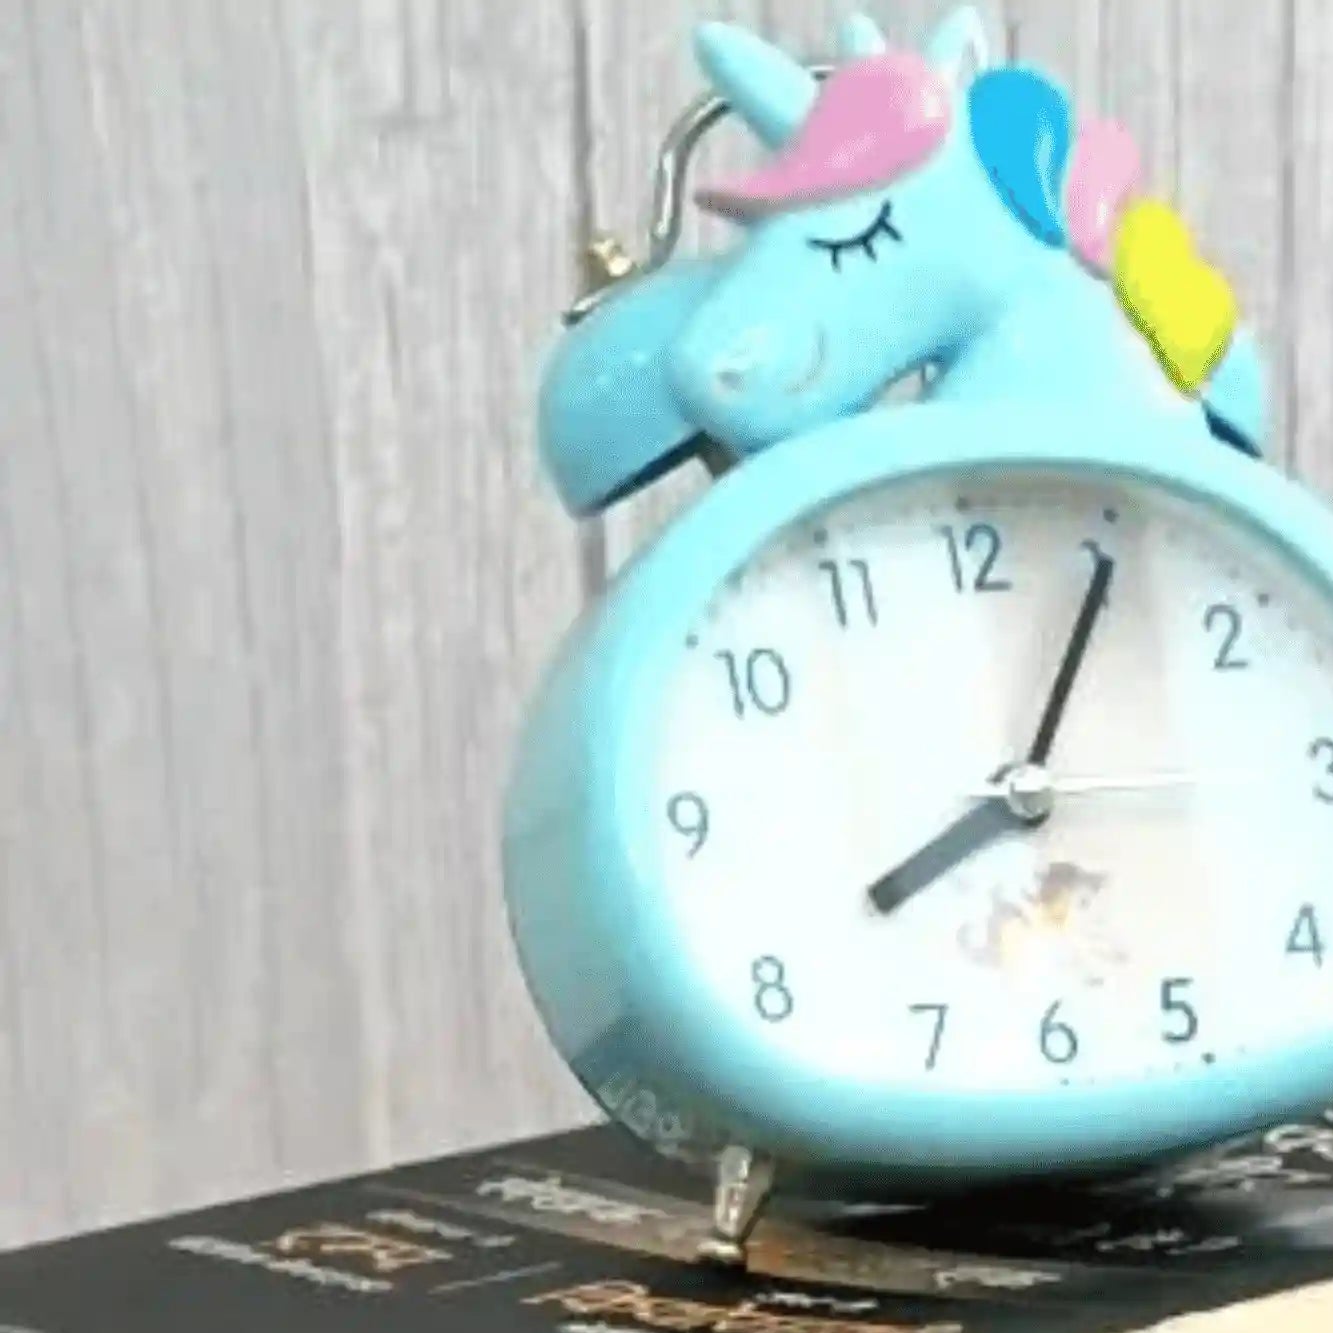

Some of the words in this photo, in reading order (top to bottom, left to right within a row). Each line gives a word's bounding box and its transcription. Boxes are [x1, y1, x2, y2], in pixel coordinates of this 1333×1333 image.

[945, 523, 1013, 593] 12
[818, 558, 880, 629] 11
[1204, 604, 1249, 670] 2
[716, 646, 791, 717] 10
[667, 794, 710, 860] 9
[1284, 904, 1325, 968] 4
[752, 955, 794, 1023] 8
[1159, 978, 1198, 1043] 5
[909, 1004, 950, 1070] 7
[1038, 1000, 1078, 1064] 6
